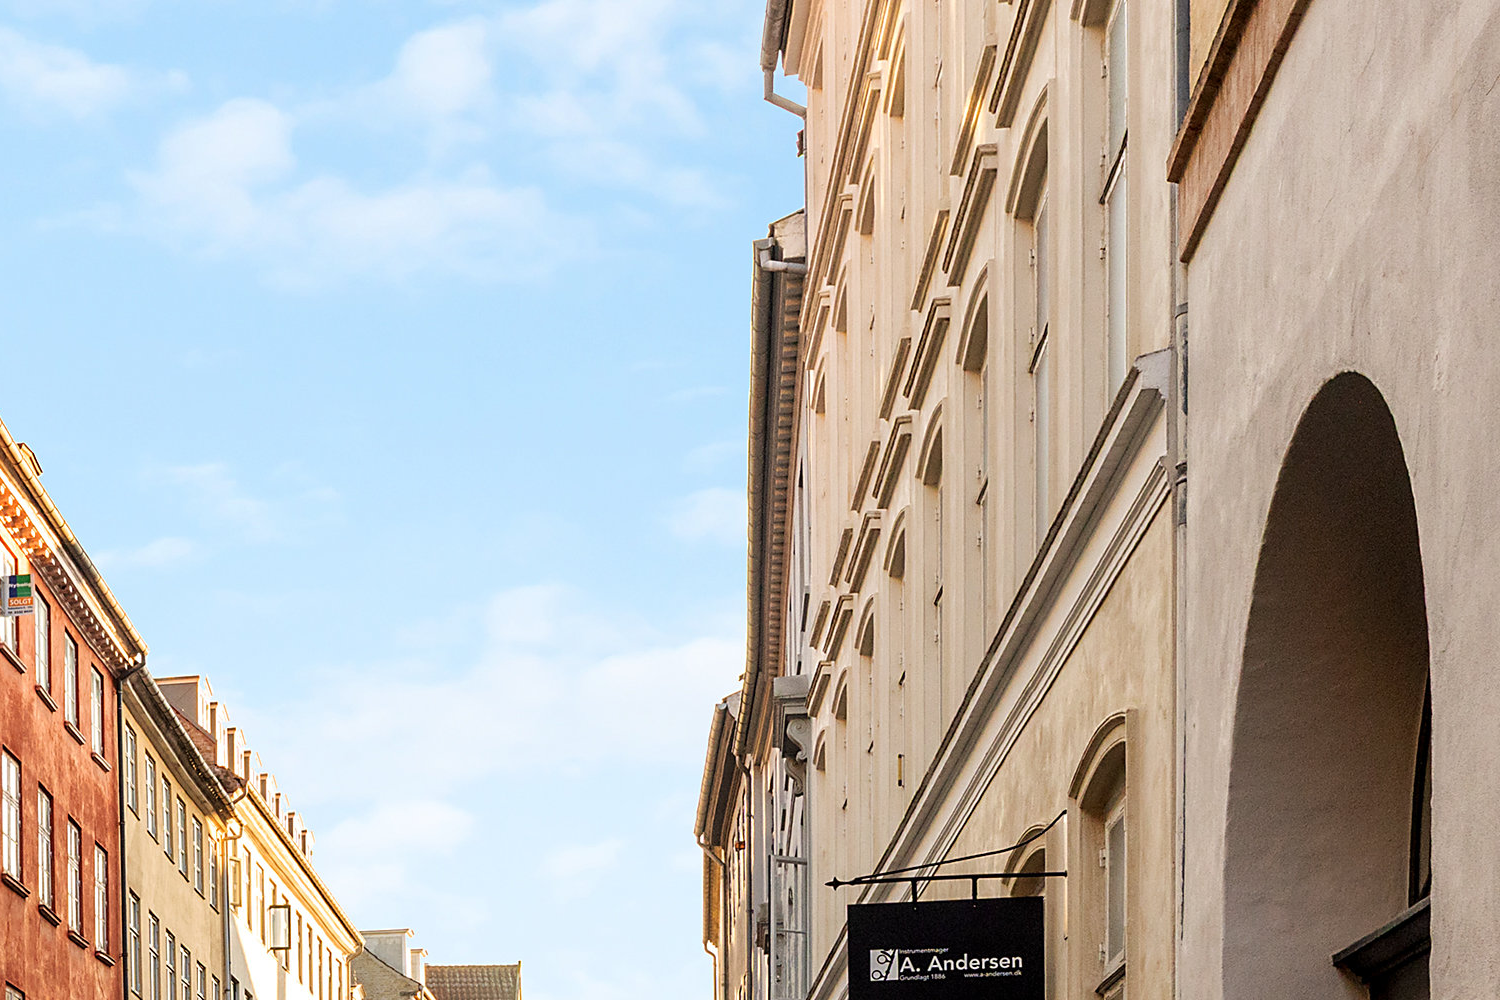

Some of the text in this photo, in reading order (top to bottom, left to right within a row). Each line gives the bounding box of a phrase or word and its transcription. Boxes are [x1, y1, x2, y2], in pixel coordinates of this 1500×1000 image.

[9, 598, 32, 606] SOLGT
[900, 953, 1023, 973] A. Andersen
[900, 973, 930, 981] Grundlagt
[963, 970, 1022, 978] www.a-andersen.dk
